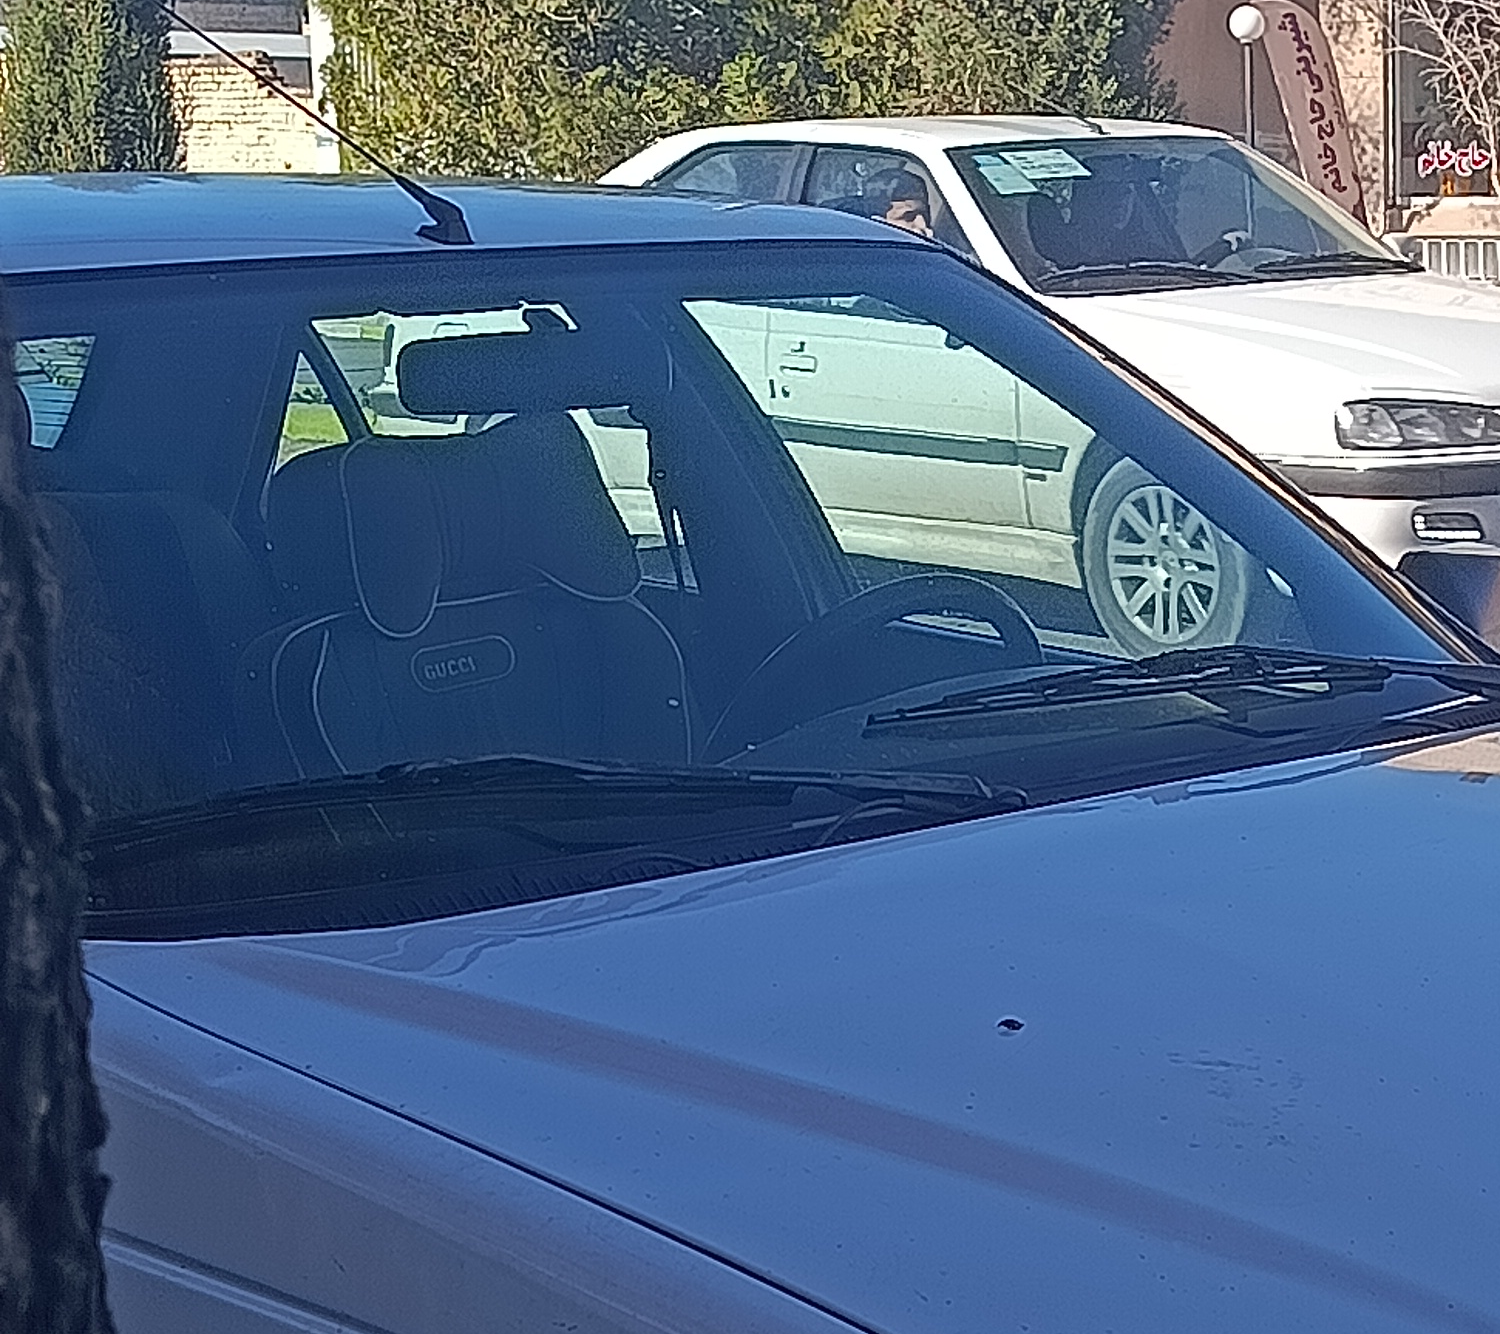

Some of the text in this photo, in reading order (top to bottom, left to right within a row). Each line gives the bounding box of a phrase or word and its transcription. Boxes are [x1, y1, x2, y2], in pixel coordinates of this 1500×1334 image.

[1277, 12, 1324, 94] شیرینی
[1308, 97, 1336, 141] حاج
[1316, 142, 1348, 193] خانم
[424, 656, 476, 680] GUCCI
